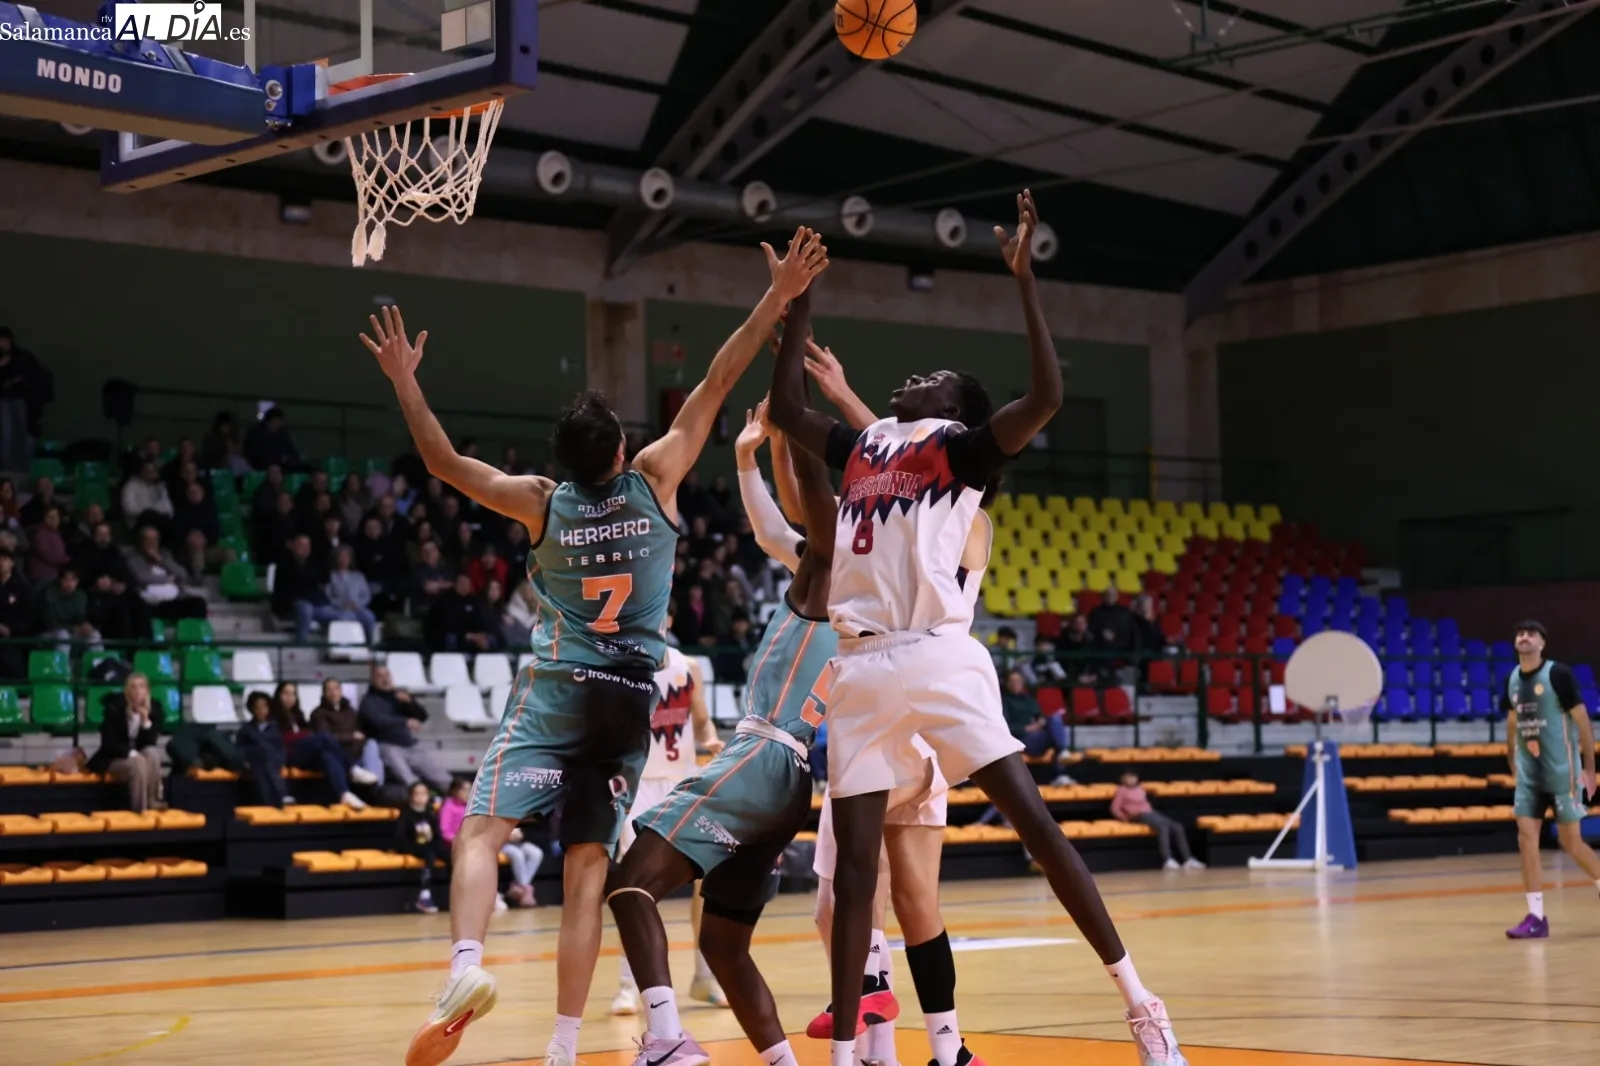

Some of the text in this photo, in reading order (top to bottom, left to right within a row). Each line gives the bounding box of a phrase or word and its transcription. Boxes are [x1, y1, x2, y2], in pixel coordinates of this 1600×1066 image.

[37, 58, 122, 94] MONDO
[560, 518, 650, 546] HERRERO
[852, 520, 874, 555] 8
[582, 573, 633, 635] 7
[588, 669, 620, 682] trouw
[665, 737, 680, 762] 5
